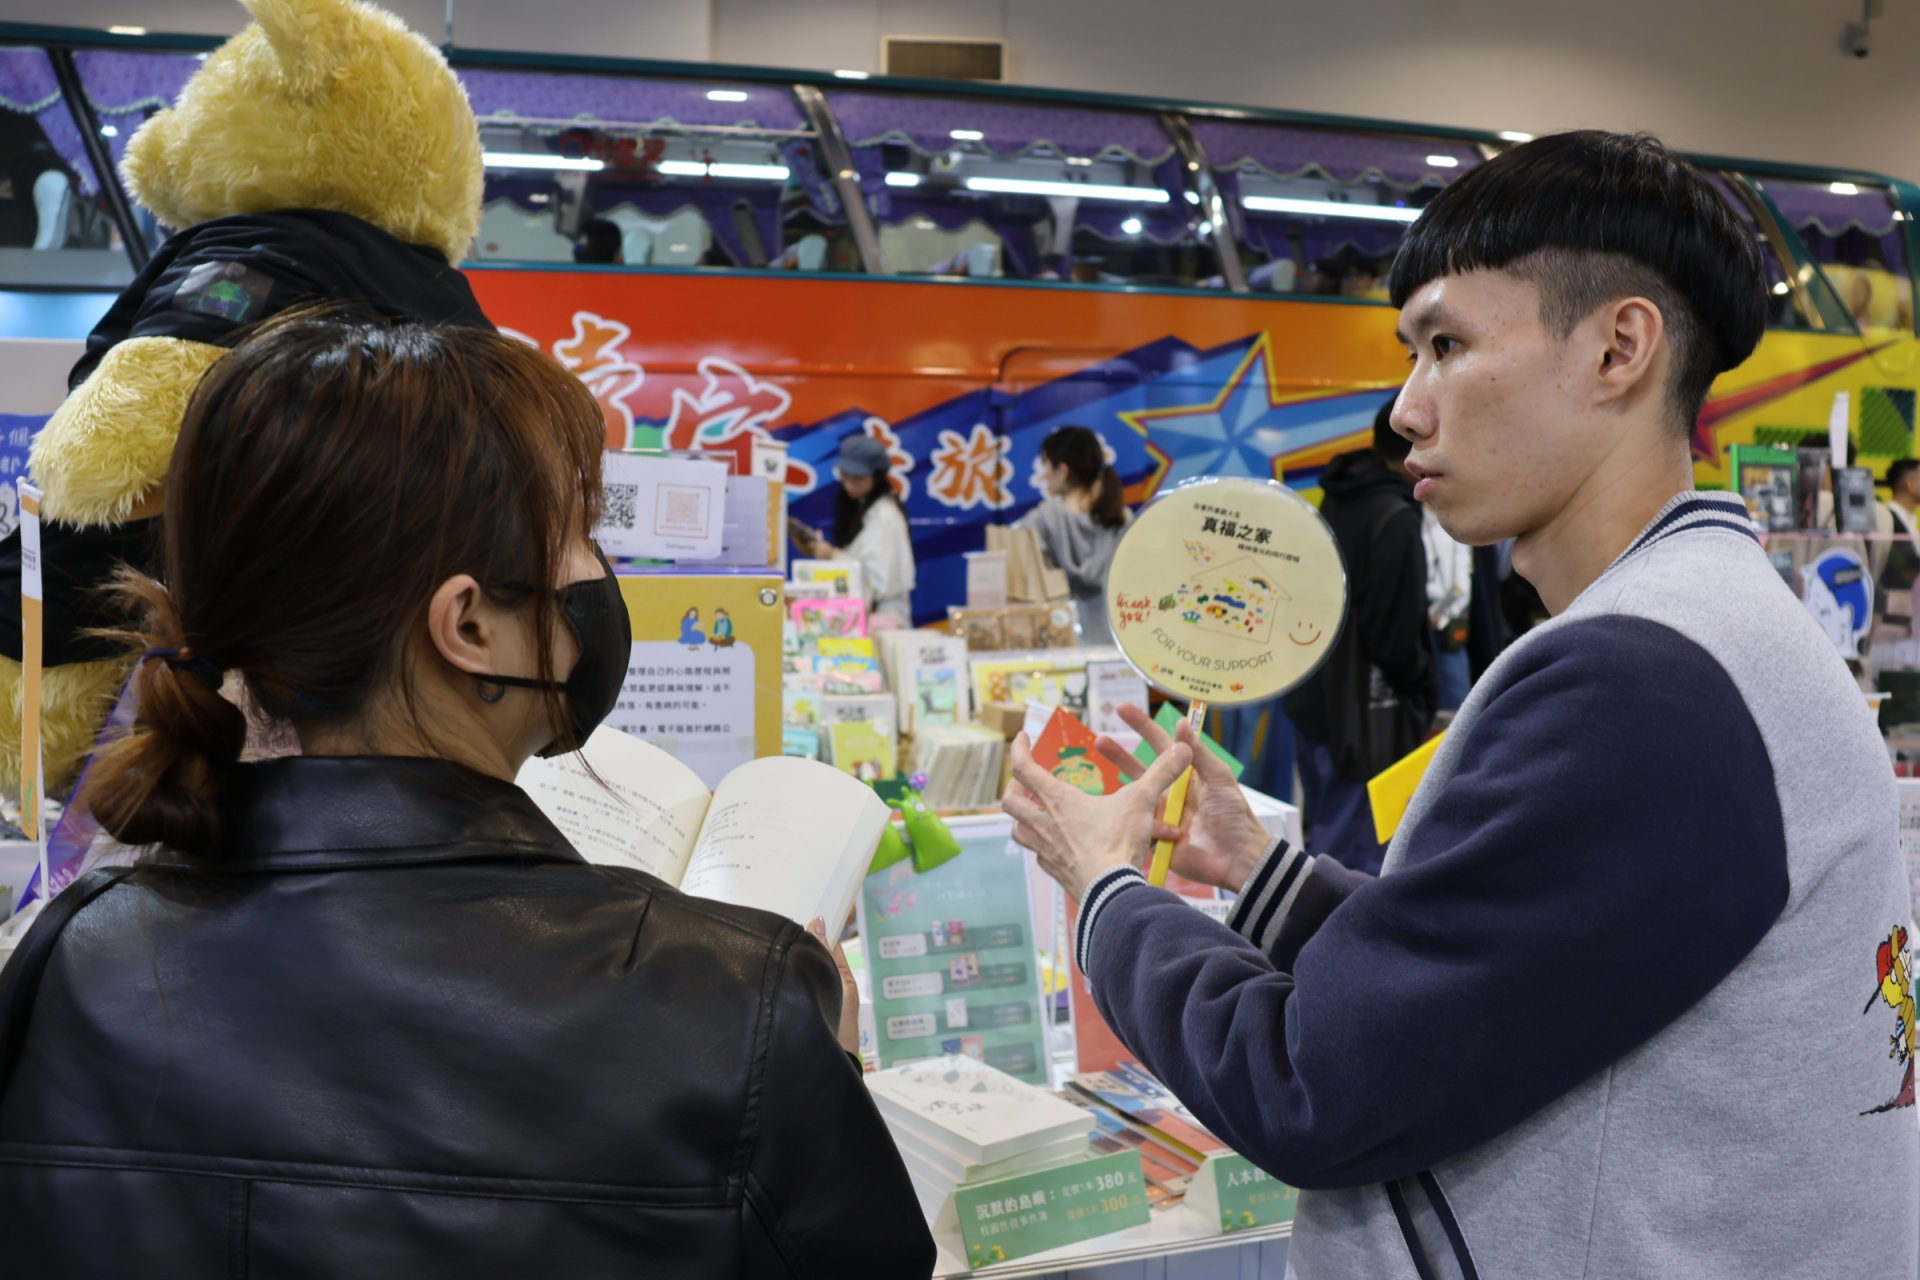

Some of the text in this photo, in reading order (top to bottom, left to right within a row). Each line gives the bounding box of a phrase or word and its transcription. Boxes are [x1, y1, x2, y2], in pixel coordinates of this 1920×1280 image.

[1201, 515, 1272, 544] 真福之家
[1152, 627, 1274, 672] FOR YOUR SUPPORT
[1096, 1171, 1124, 1192] 380
[1100, 1193, 1129, 1215] 300
